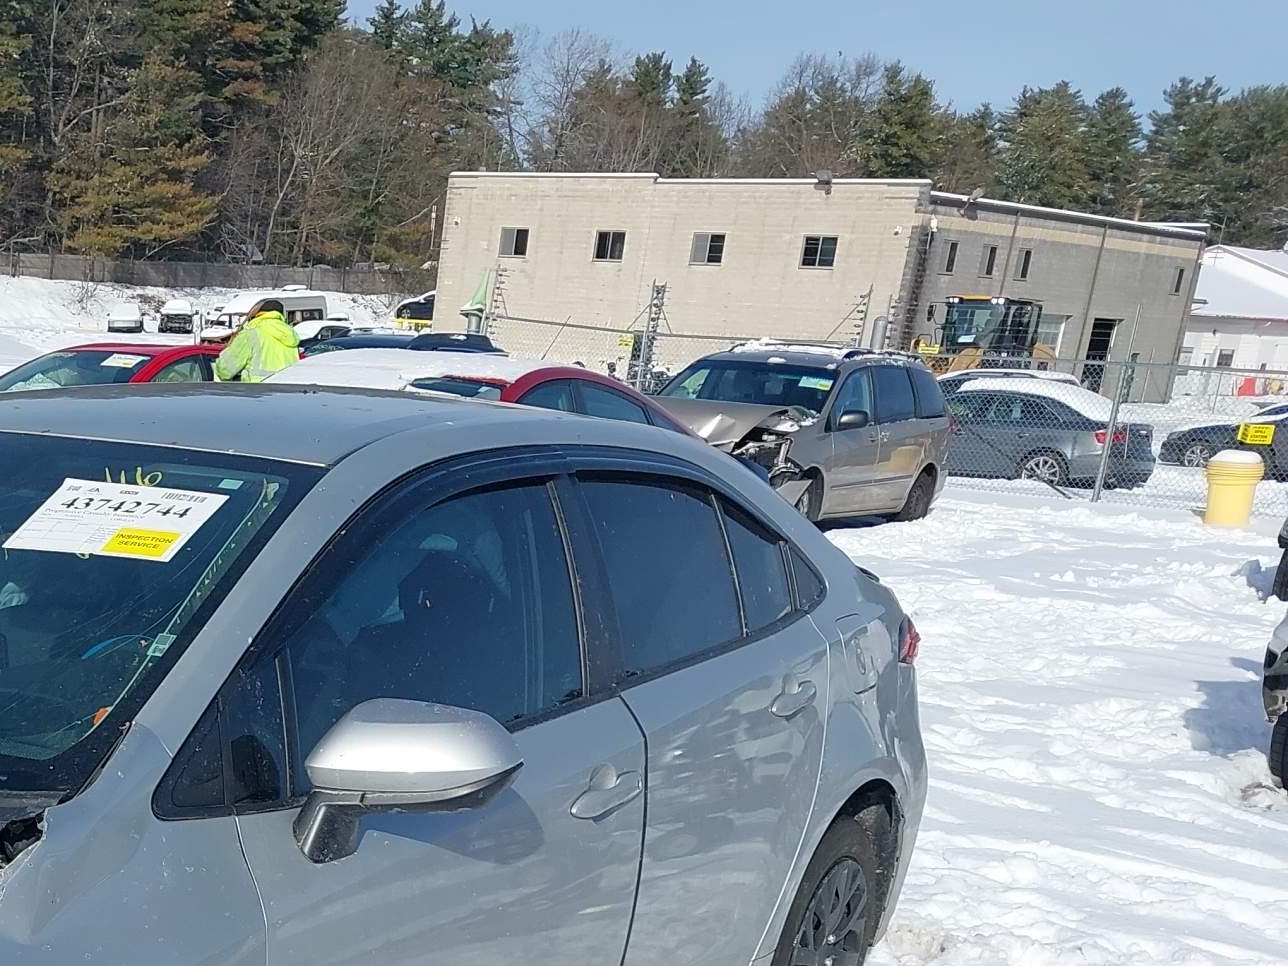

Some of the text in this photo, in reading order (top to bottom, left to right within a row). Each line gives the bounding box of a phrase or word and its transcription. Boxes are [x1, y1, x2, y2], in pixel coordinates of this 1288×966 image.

[60, 496, 193, 519] 43742744
[116, 533, 174, 545] INSPECTION
[117, 540, 161, 549] SERVICE
